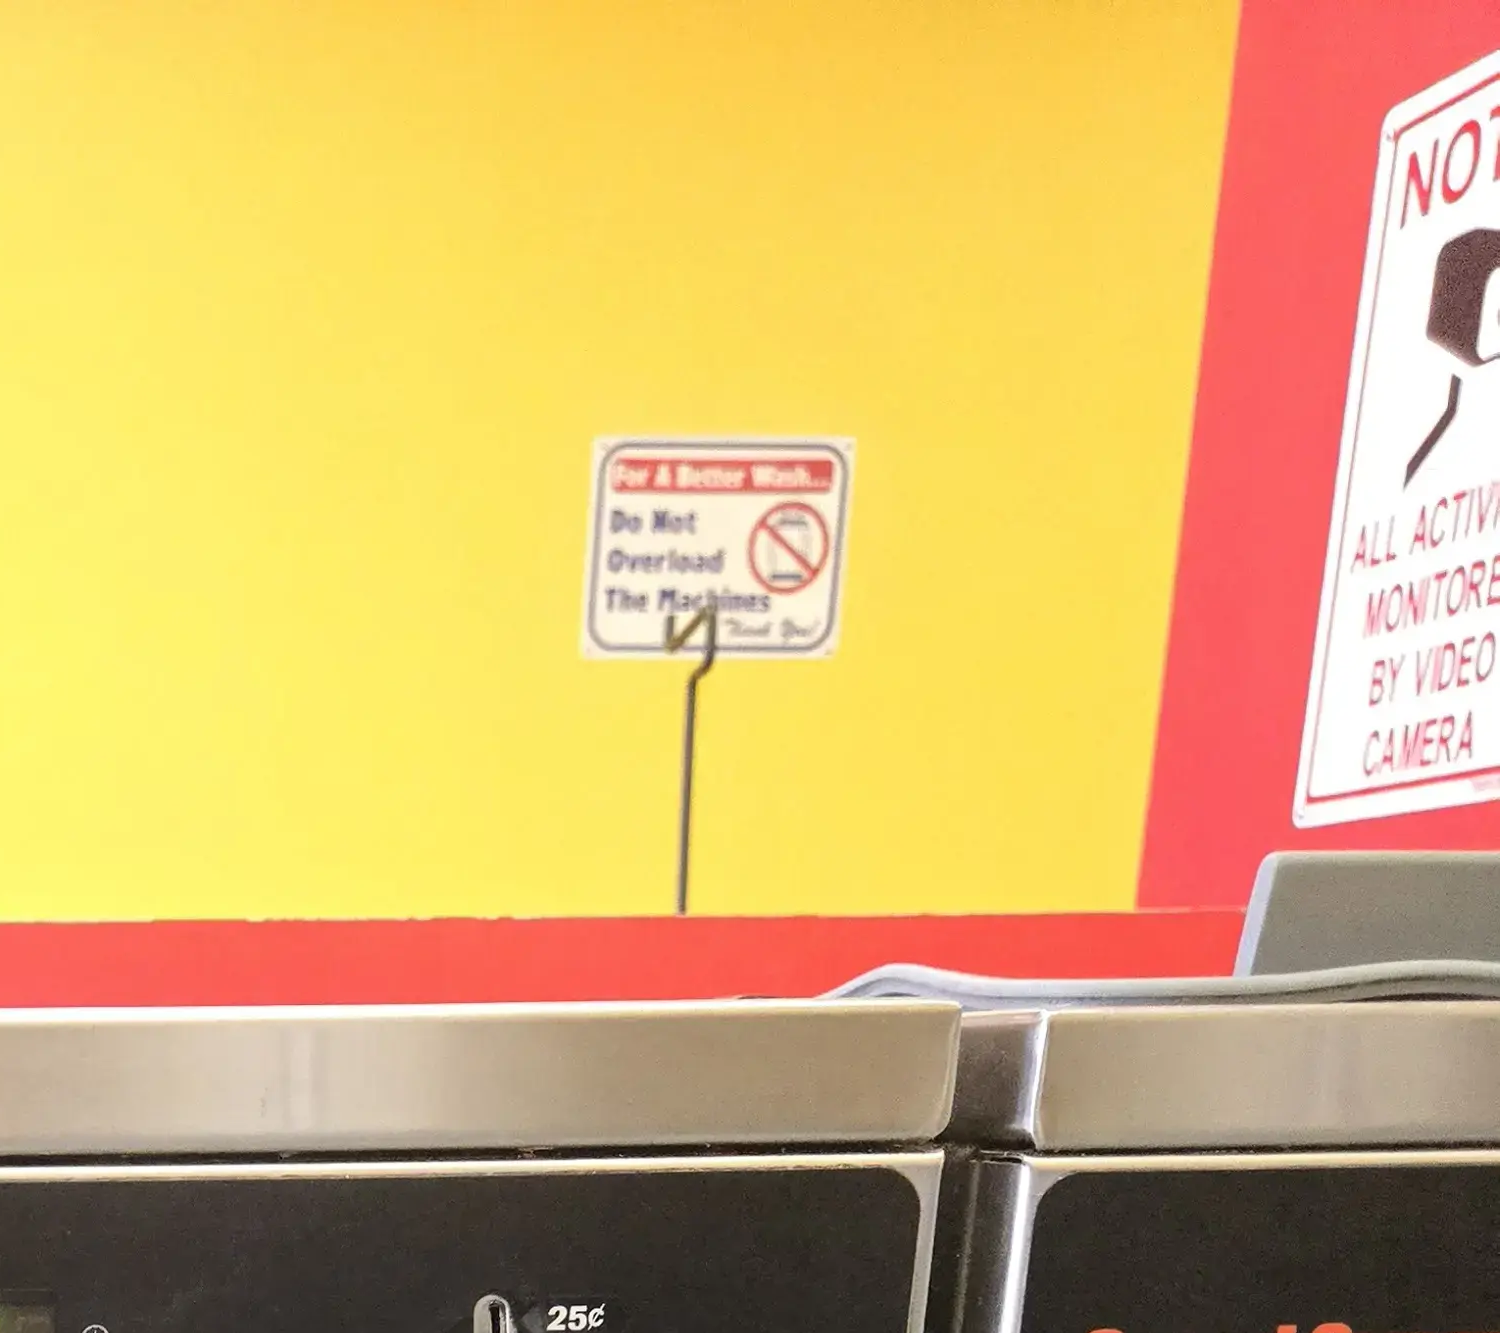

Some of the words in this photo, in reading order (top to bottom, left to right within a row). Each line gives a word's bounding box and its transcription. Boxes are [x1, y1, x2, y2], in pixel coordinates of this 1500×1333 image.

[610, 510, 642, 534] Do
[651, 510, 698, 534] Not
[1350, 516, 1397, 574] ALL
[607, 548, 726, 574] Overload
[606, 588, 649, 613] The
[658, 586, 771, 613] Machines
[1368, 653, 1406, 708] BY
[1416, 631, 1496, 697] VIDEO
[1362, 709, 1473, 778] CAMERA
[546, 1303, 605, 1331] 25¢
